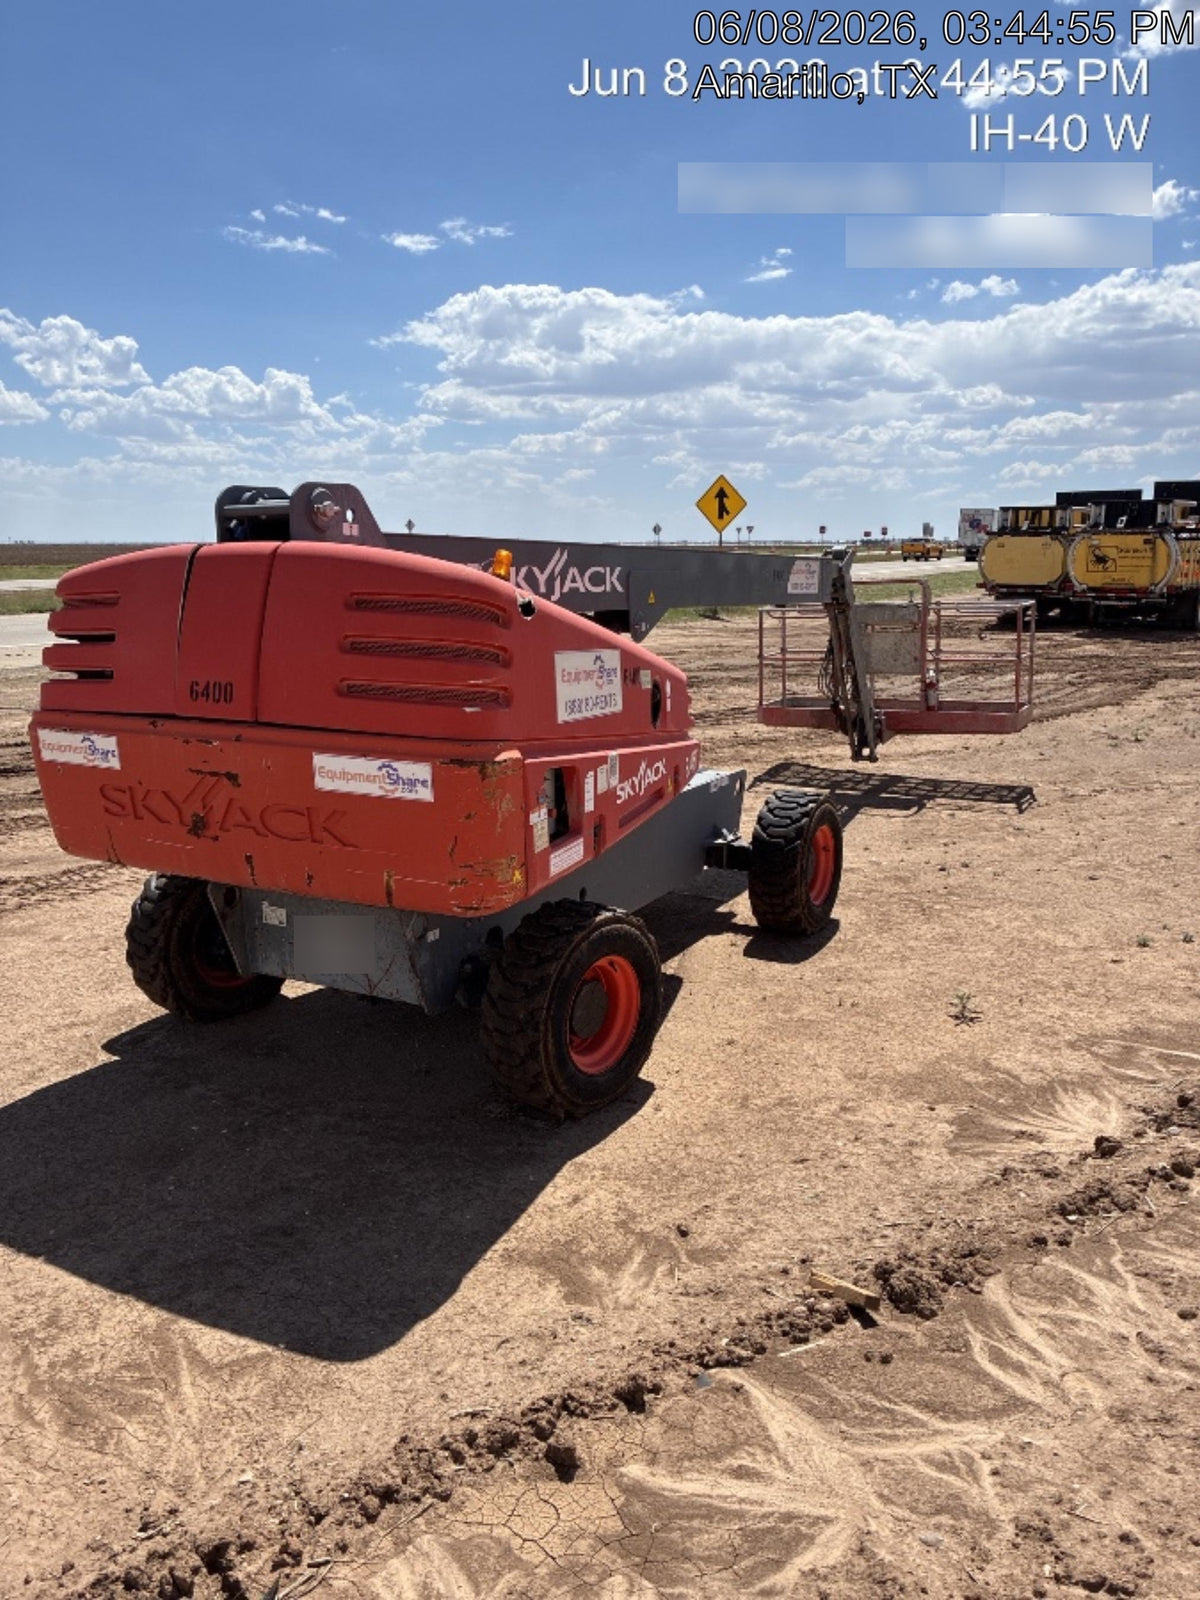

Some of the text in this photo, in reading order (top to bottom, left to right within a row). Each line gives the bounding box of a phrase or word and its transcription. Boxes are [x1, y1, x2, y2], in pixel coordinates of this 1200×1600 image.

[509, 547, 625, 602] KYJACK
[190, 680, 233, 705] 6400
[616, 756, 669, 805] SKYJACK
